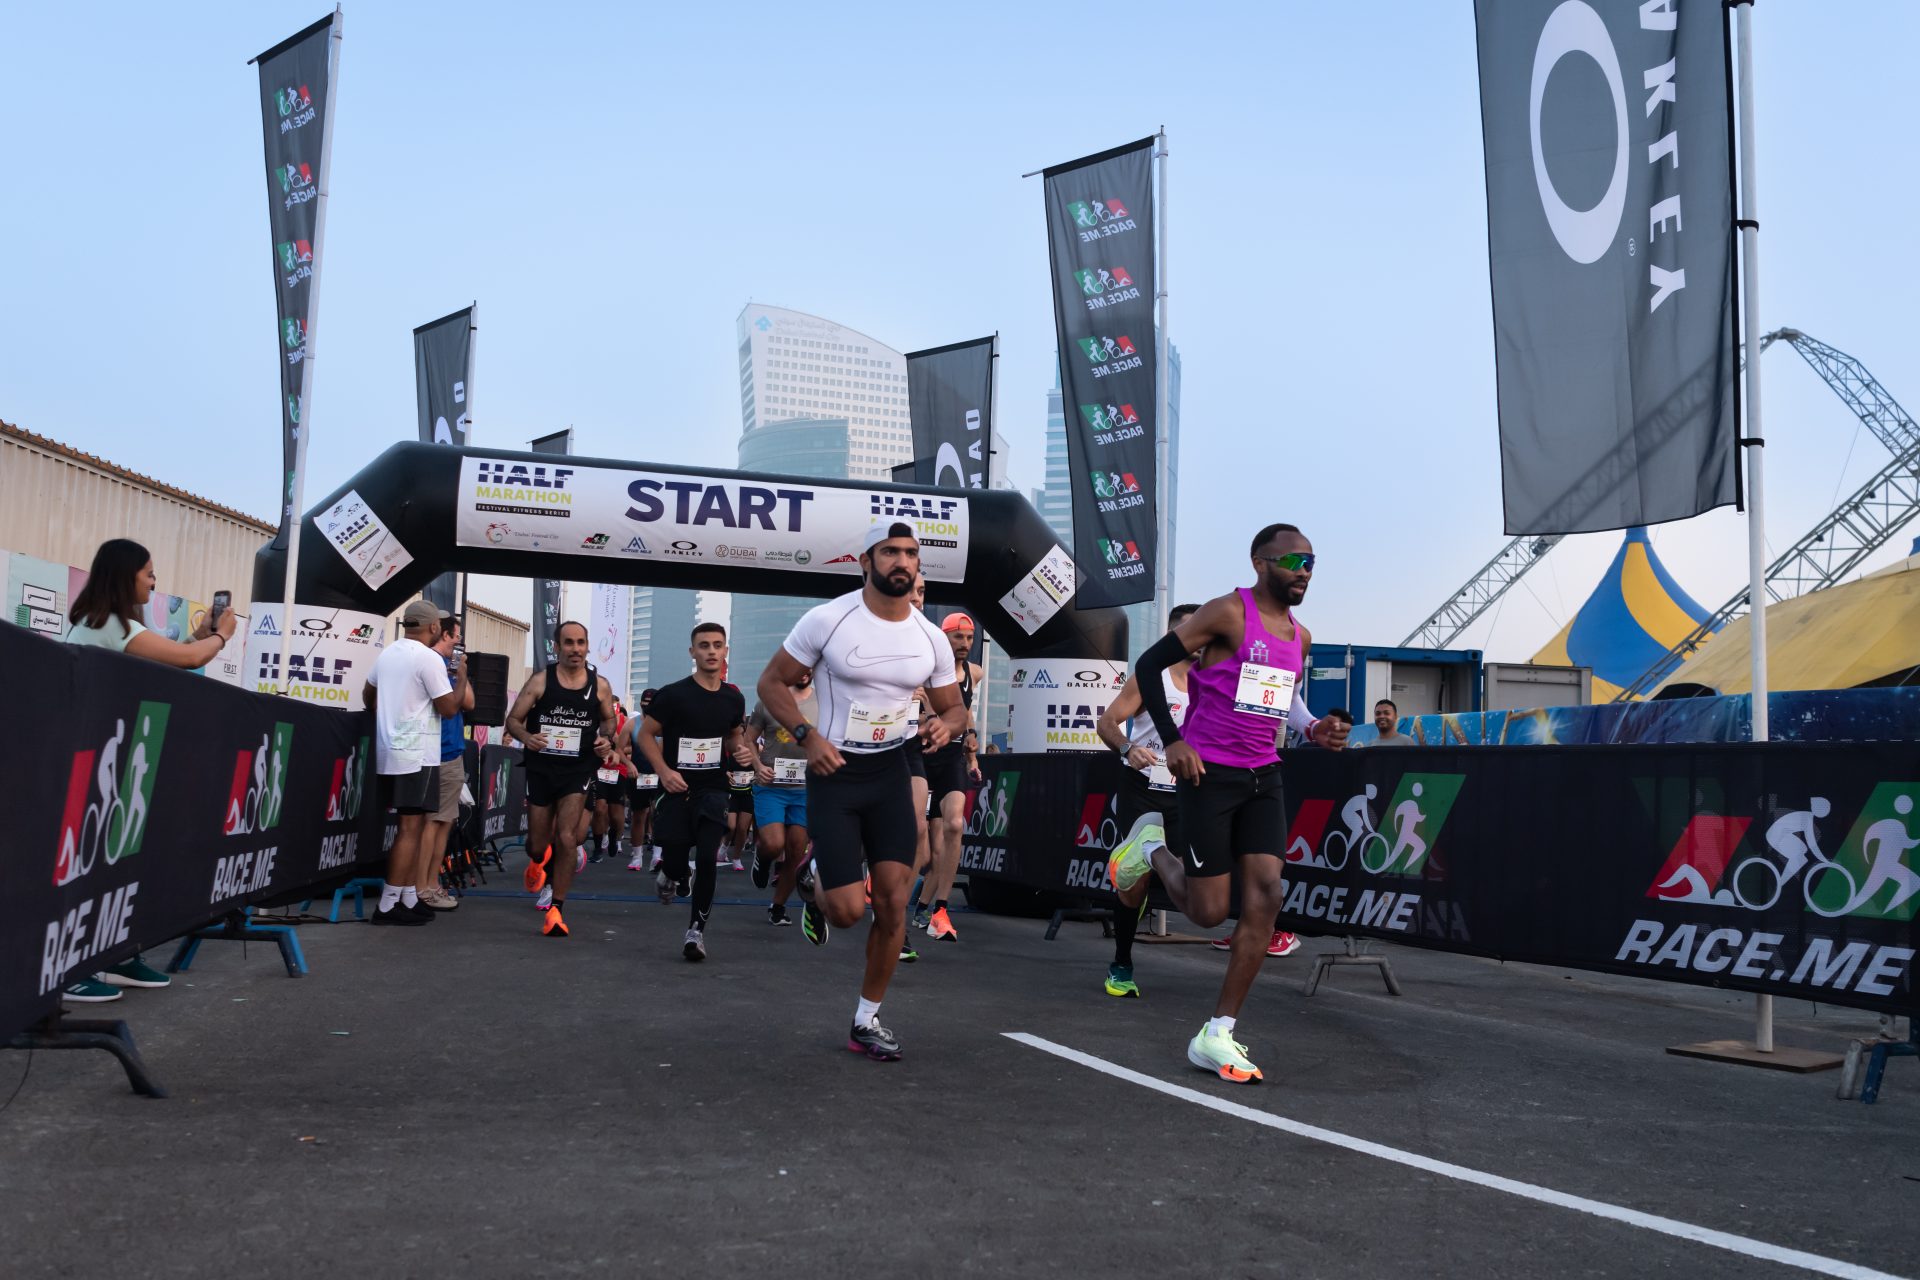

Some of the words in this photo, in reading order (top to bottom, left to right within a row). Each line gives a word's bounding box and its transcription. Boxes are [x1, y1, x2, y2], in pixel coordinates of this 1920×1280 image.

[478, 462, 573, 489] HALF
[476, 486, 572, 505] MARATHON
[477, 504, 510, 512] FESTIVAL
[513, 507, 542, 515] FITNESS
[544, 509, 570, 517] SERIES
[625, 478, 815, 533] START
[871, 495, 957, 520] HALF
[730, 548, 757, 557] DUBAI
[291, 629, 340, 640] OAKLEY
[260, 652, 352, 684] HALF
[258, 682, 350, 702] MAATHON
[1262, 690, 1275, 705] 83
[540, 715, 551, 723] Bin
[872, 728, 886, 741] 68
[1047, 732, 1101, 744] MARAT
[555, 739, 564, 749] 59
[696, 753, 705, 763] 30
[785, 769, 796, 779] 308
[318, 833, 359, 871] RACE.ME
[210, 846, 278, 904] RACE.ME
[1615, 919, 1916, 996] RACE.ME
